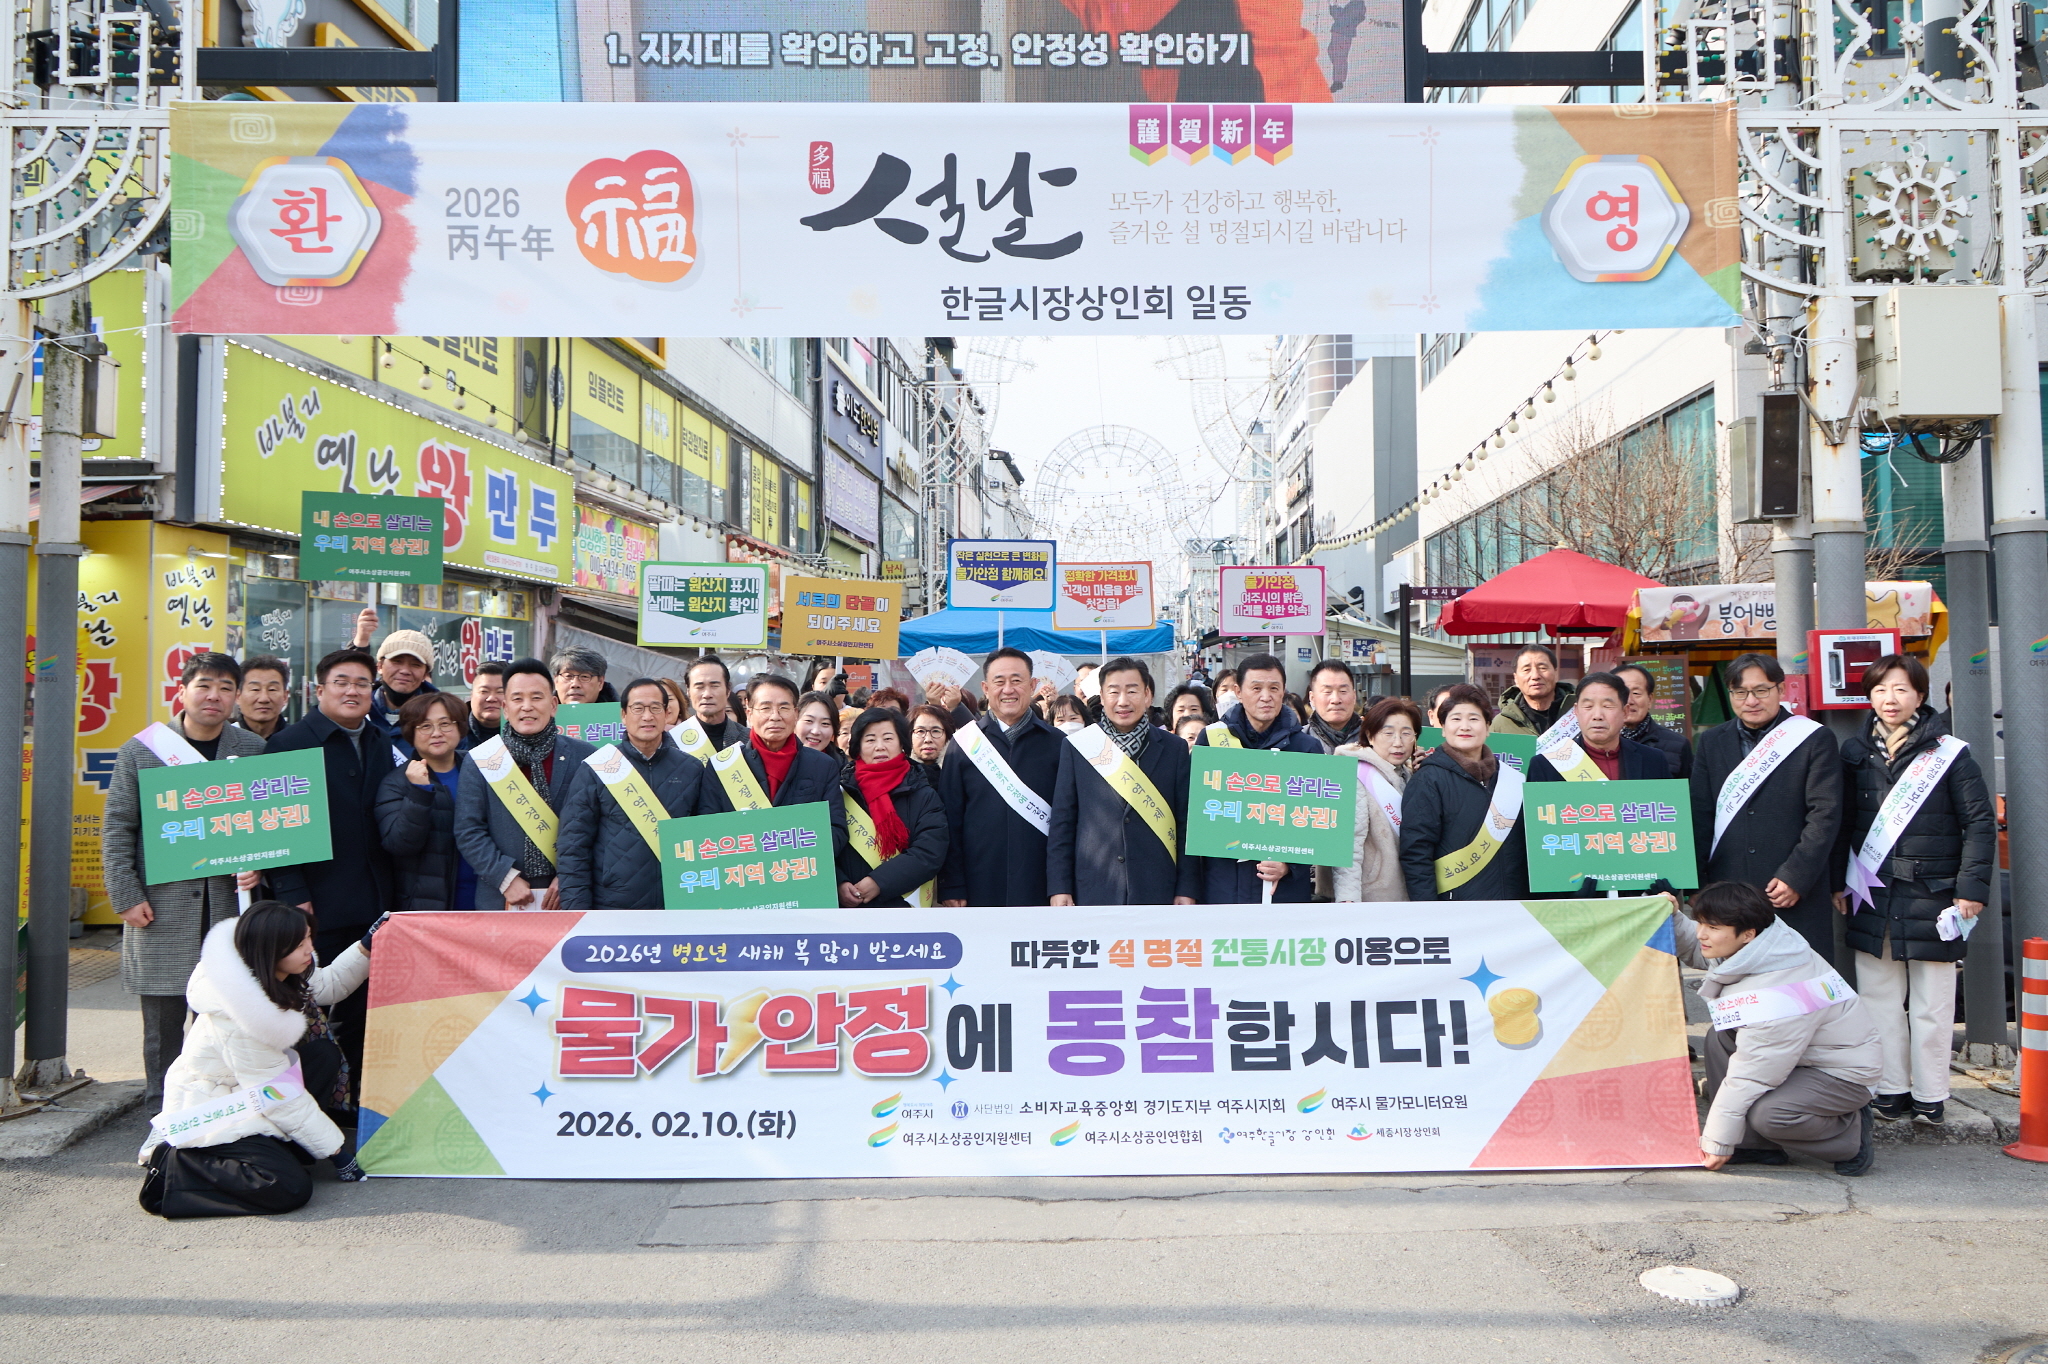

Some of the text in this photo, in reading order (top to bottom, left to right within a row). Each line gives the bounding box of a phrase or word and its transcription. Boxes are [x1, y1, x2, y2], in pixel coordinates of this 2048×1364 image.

[605, 32, 1250, 68] 1. 지지대를 확인하고 고정, 안정성 확인하기
[1138, 118, 1286, 145] 謹賀新年
[811, 143, 831, 190] 多福
[445, 187, 521, 218] 2026
[799, 151, 1084, 263] 설날
[1108, 189, 1341, 215] 모두가 건강하고 행복한,
[269, 187, 343, 255] 환
[579, 166, 695, 264] 福
[1585, 184, 1640, 252] 영
[446, 224, 555, 261] 丙午年
[1108, 219, 1407, 245] 즐거운 설 명절되시길 바랍니다
[941, 285, 1252, 322] 한글시장상인회 일동
[588, 370, 624, 413] 임플란트
[313, 510, 433, 532] 내 손으로 살리는
[314, 534, 430, 556] 우리 지역 상권!
[956, 551, 1048, 562] 작은 실천으로 큰 변화를
[885, 563, 903, 573] 낚시
[956, 567, 1048, 581] 물가안정 함께해요!
[1064, 569, 1138, 582] 정확한 가격표시
[648, 575, 760, 593] 팔때는 원산지 표시!
[1062, 584, 1143, 596] 고객의 마음을 얻는
[1244, 575, 1299, 590] 물가안정,
[647, 595, 759, 614] 살때는 원산지 확인!
[796, 591, 889, 612] 서로의 단골이
[1086, 597, 1120, 610] 첫걸음!
[1241, 592, 1303, 604] 여주시의 밝은
[1233, 604, 1311, 616] 미래를 위한 약속!
[807, 614, 881, 633] 되어주세요
[156, 775, 310, 811] 내 손으로 살리는
[1203, 770, 1342, 799] 내 손으로 살리는
[161, 804, 311, 844] 우리 지역 상권!
[1203, 799, 1338, 830] 우리 지역 상권!
[1537, 802, 1677, 825] 내 손으로 살리는
[675, 827, 817, 861] 내 손으로 살리는
[1241, 842, 1315, 856] 여주시소상공인지원센터
[1542, 831, 1678, 855] 우리 지역 상권!
[209, 848, 290, 866] 여주시소상공인지원센터
[679, 857, 818, 893] 우리 지역 상권!
[585, 938, 946, 966] 2026년 병오년 새해 복 많이 받으세요
[1010, 936, 1452, 970] 따뜻한 설 명절 전통시장 이용으로
[901, 1109, 934, 1119] 여주시
[973, 1098, 1286, 1117] 사단법인 소비자교육중앙회 경기도지부 여주시지회
[1331, 1094, 1469, 1111] 여주시 물가모니터요원
[556, 1110, 798, 1141] 2026. 02.10.(화)
[902, 1130, 1032, 1147] 여주시소상공인지원센터
[1085, 1129, 1203, 1146] 여주시소상공인연합회
